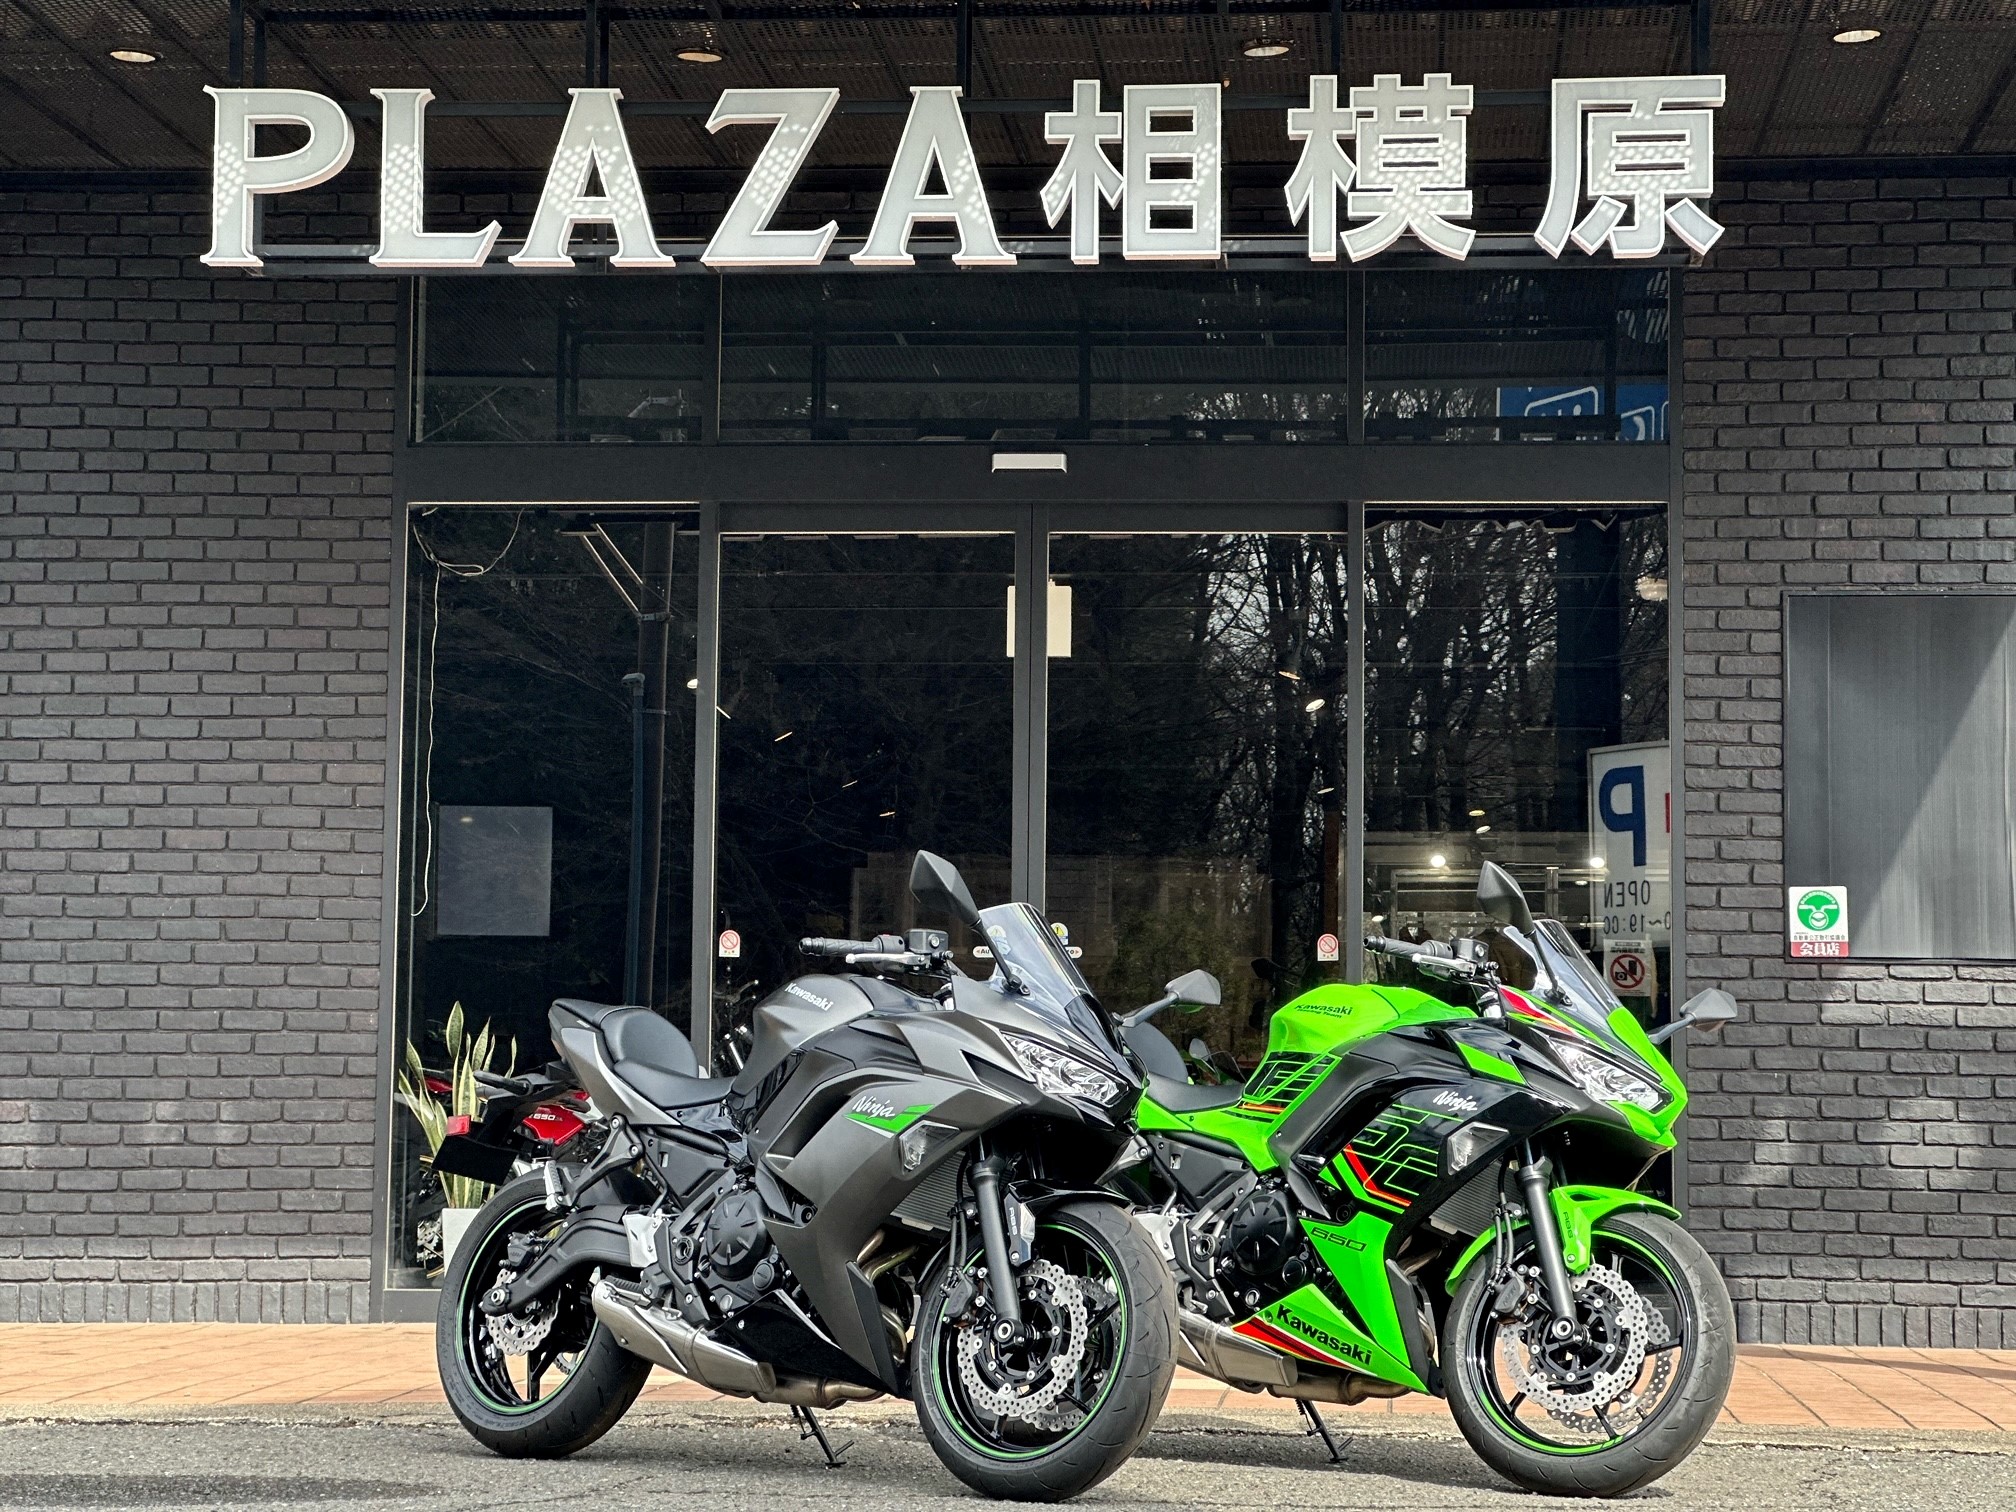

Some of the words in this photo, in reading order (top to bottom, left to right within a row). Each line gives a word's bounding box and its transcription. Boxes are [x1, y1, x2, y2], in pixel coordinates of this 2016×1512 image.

[201, 83, 1018, 268] PLAZA
[1039, 73, 1726, 265] 相模原
[1800, 942, 1840, 956] 会員店
[785, 982, 834, 1012] Kawasaki
[1294, 1004, 1353, 1015] Kawasaki
[852, 1095, 896, 1119] Ninja
[1432, 1090, 1478, 1112] Ninja
[1562, 1211, 1574, 1239] ABS
[1310, 1227, 1367, 1252] 650
[1276, 1303, 1373, 1366] Kawasaki
